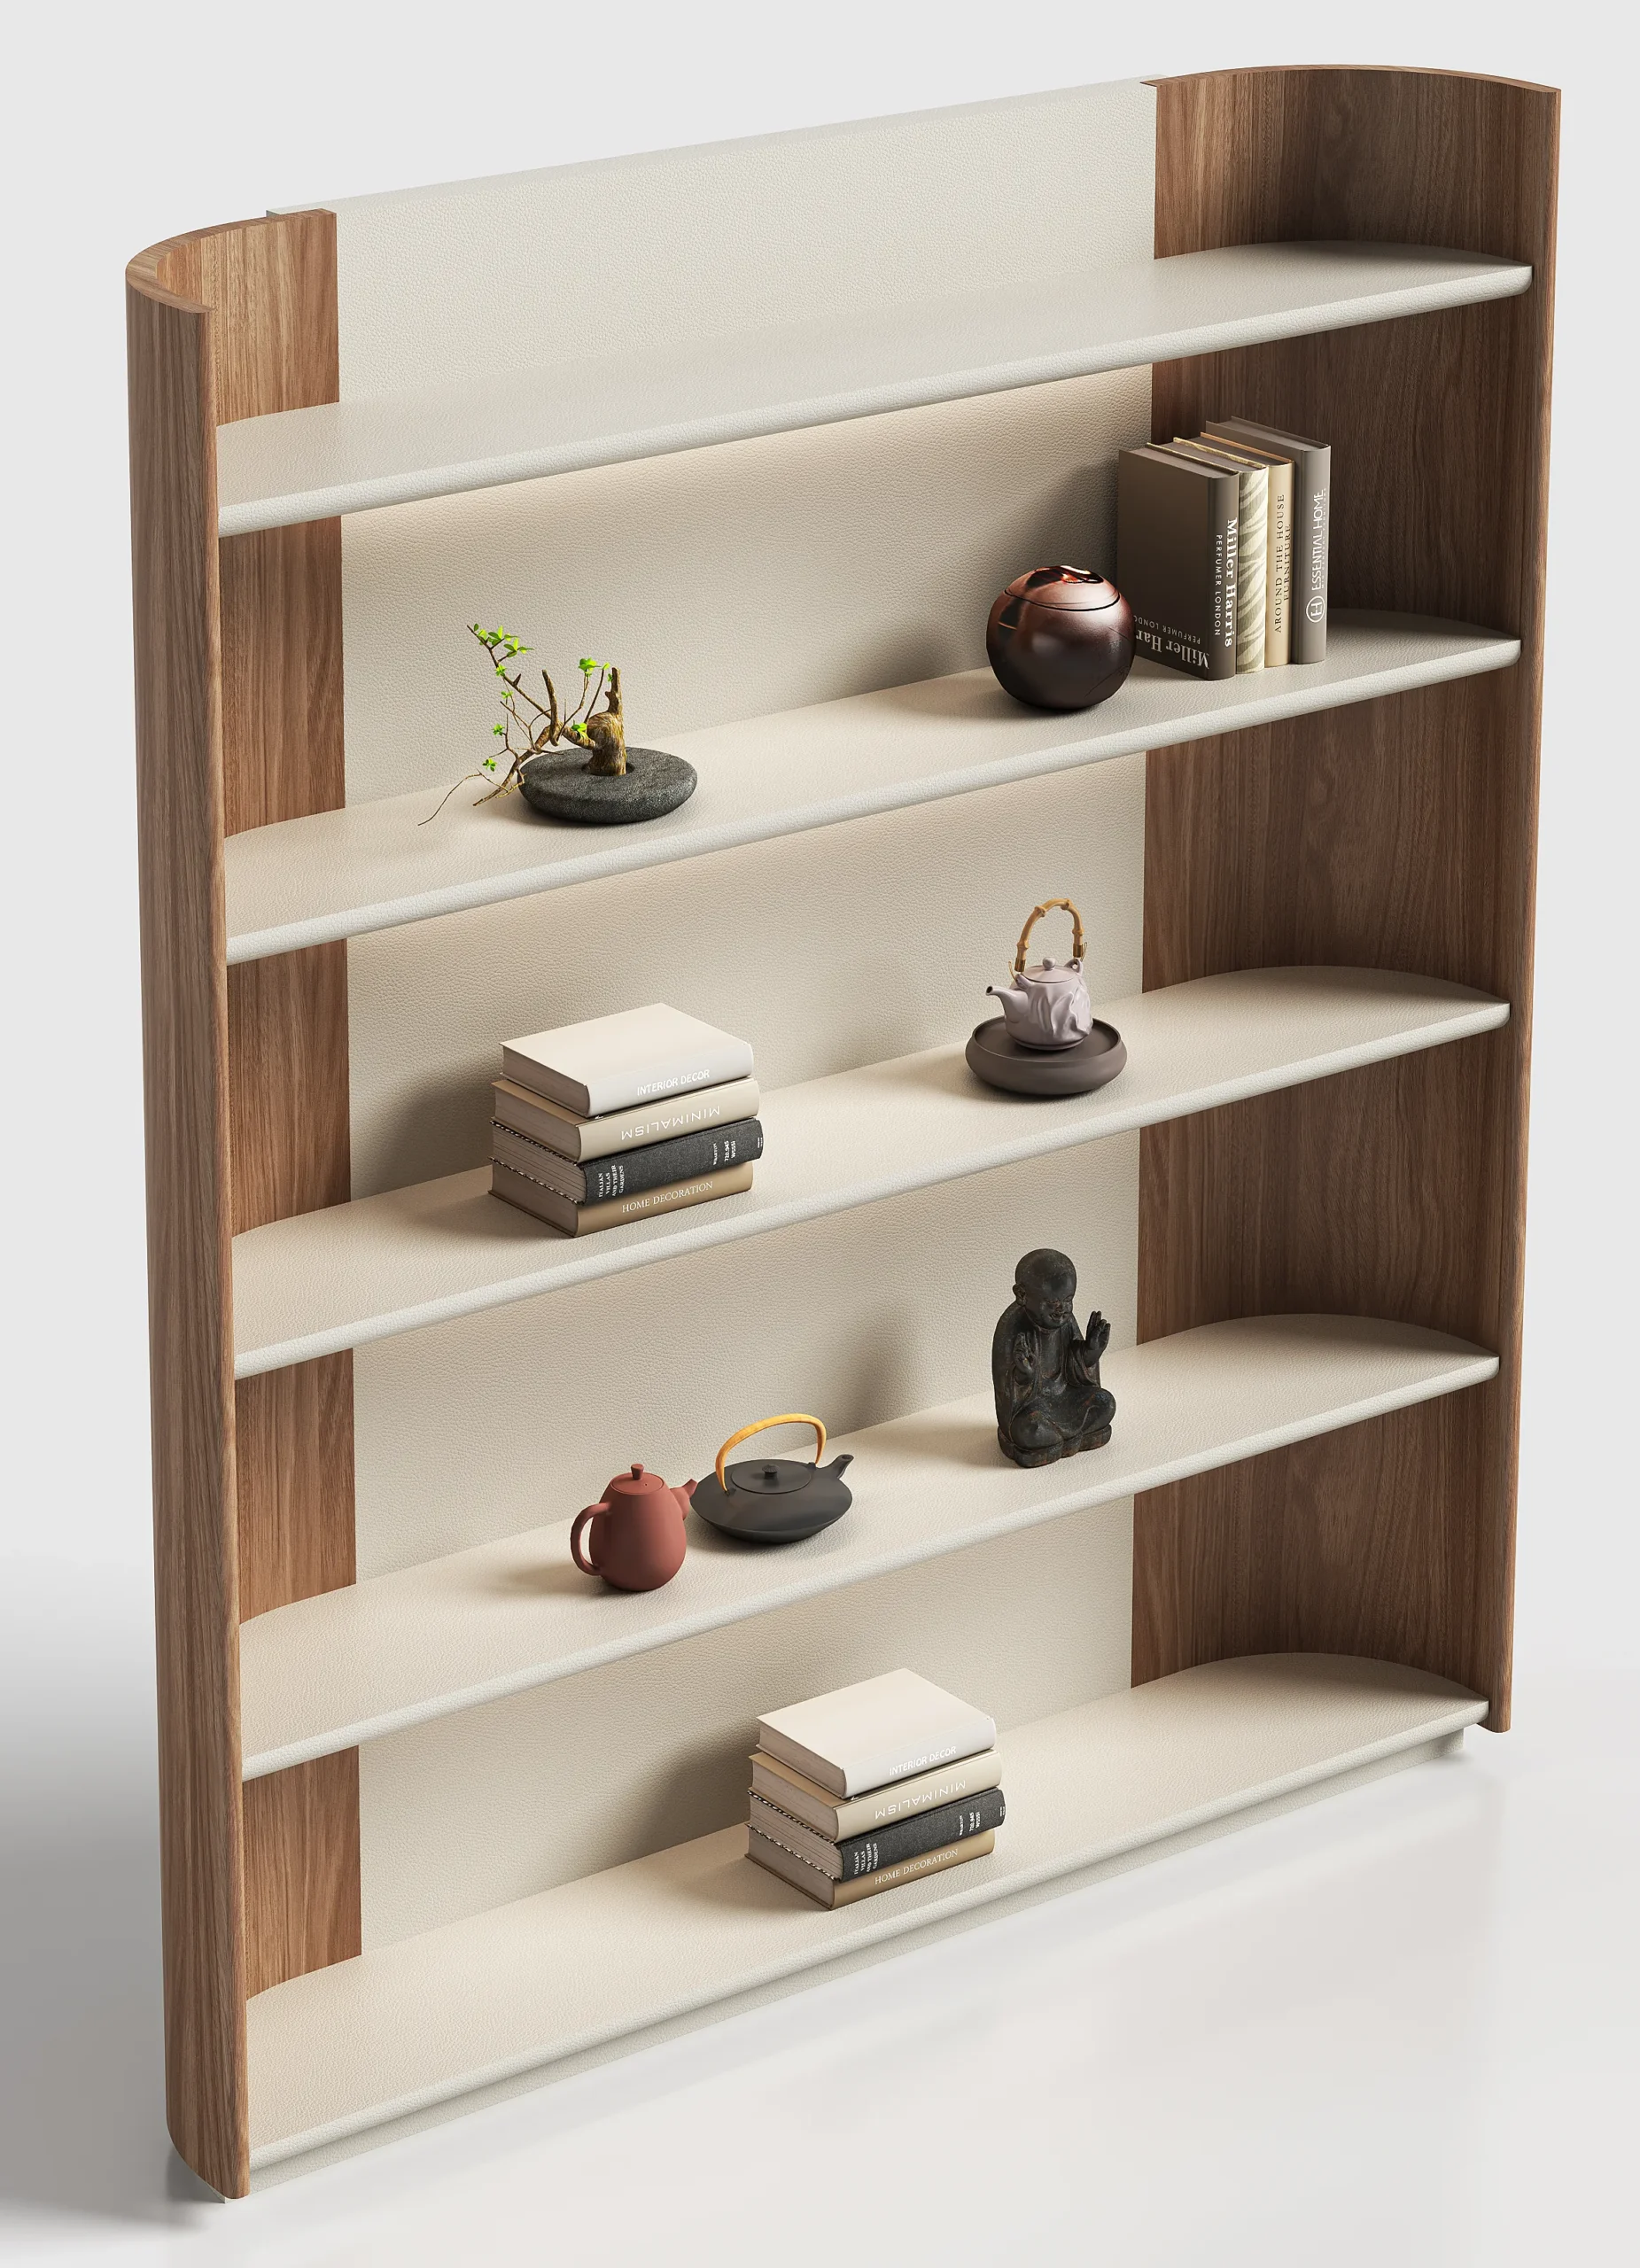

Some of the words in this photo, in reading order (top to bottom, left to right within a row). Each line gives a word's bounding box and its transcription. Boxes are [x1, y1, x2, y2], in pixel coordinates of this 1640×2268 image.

[1313, 490, 1324, 530] HOME
[1226, 517, 1238, 579] Miller
[1311, 531, 1322, 590] ESSENTIAL
[1224, 583, 1236, 648] Harris
[1274, 577, 1283, 633] AROUND
[1135, 629, 1162, 653] Har
[1162, 625, 1201, 644] PERFUMER
[1165, 640, 1209, 670] Miller
[637, 1076, 679, 1097] INTERIOR
[680, 1069, 711, 1085] DECOR
[621, 1105, 720, 1141] MINIMALISM
[622, 1198, 650, 1213] HOME
[653, 1181, 713, 1205] DECORATION
[889, 1757, 928, 1776] INTERIOR
[929, 1745, 957, 1762] DECOR
[875, 1780, 966, 1820] MINIMALISM
[874, 1868, 901, 1885] HOME
[903, 1848, 958, 1875] DECORATION
